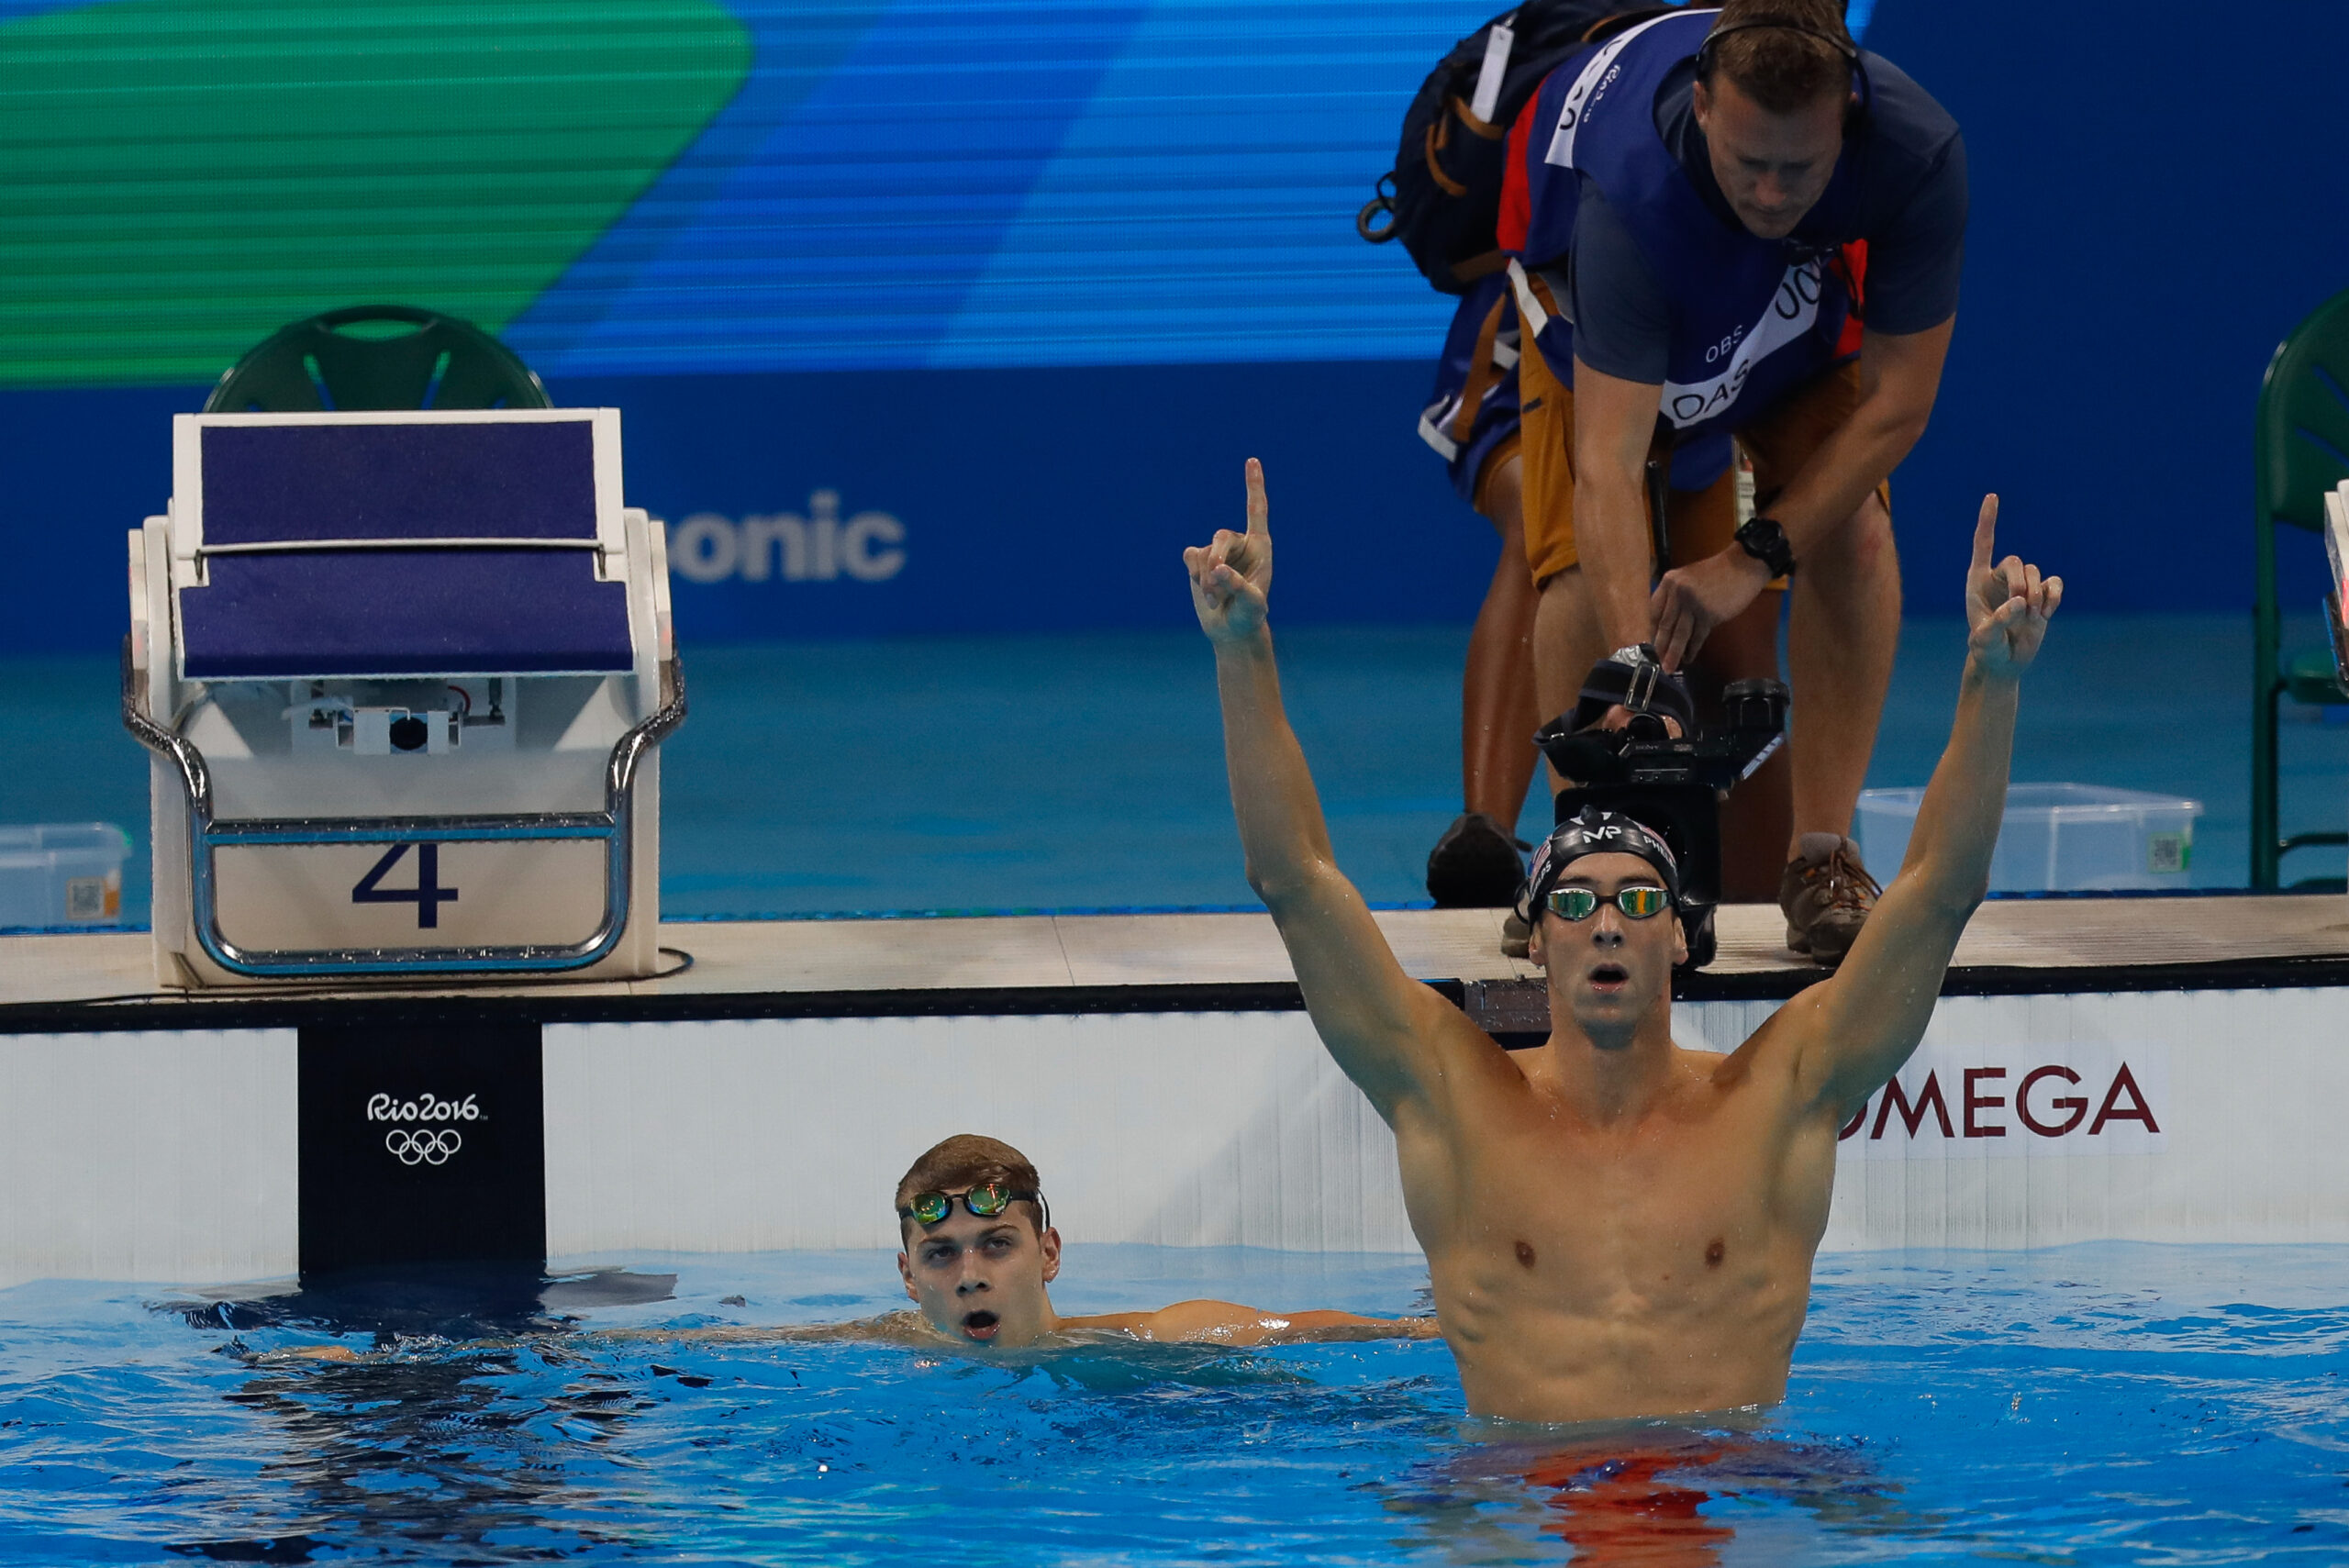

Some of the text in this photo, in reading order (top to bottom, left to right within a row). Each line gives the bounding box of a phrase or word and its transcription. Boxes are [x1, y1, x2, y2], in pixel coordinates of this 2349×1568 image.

[1706, 325, 1742, 363] OBS
[668, 488, 907, 583] onic
[351, 842, 459, 929] 4
[1838, 1061, 2161, 1141] MEGA
